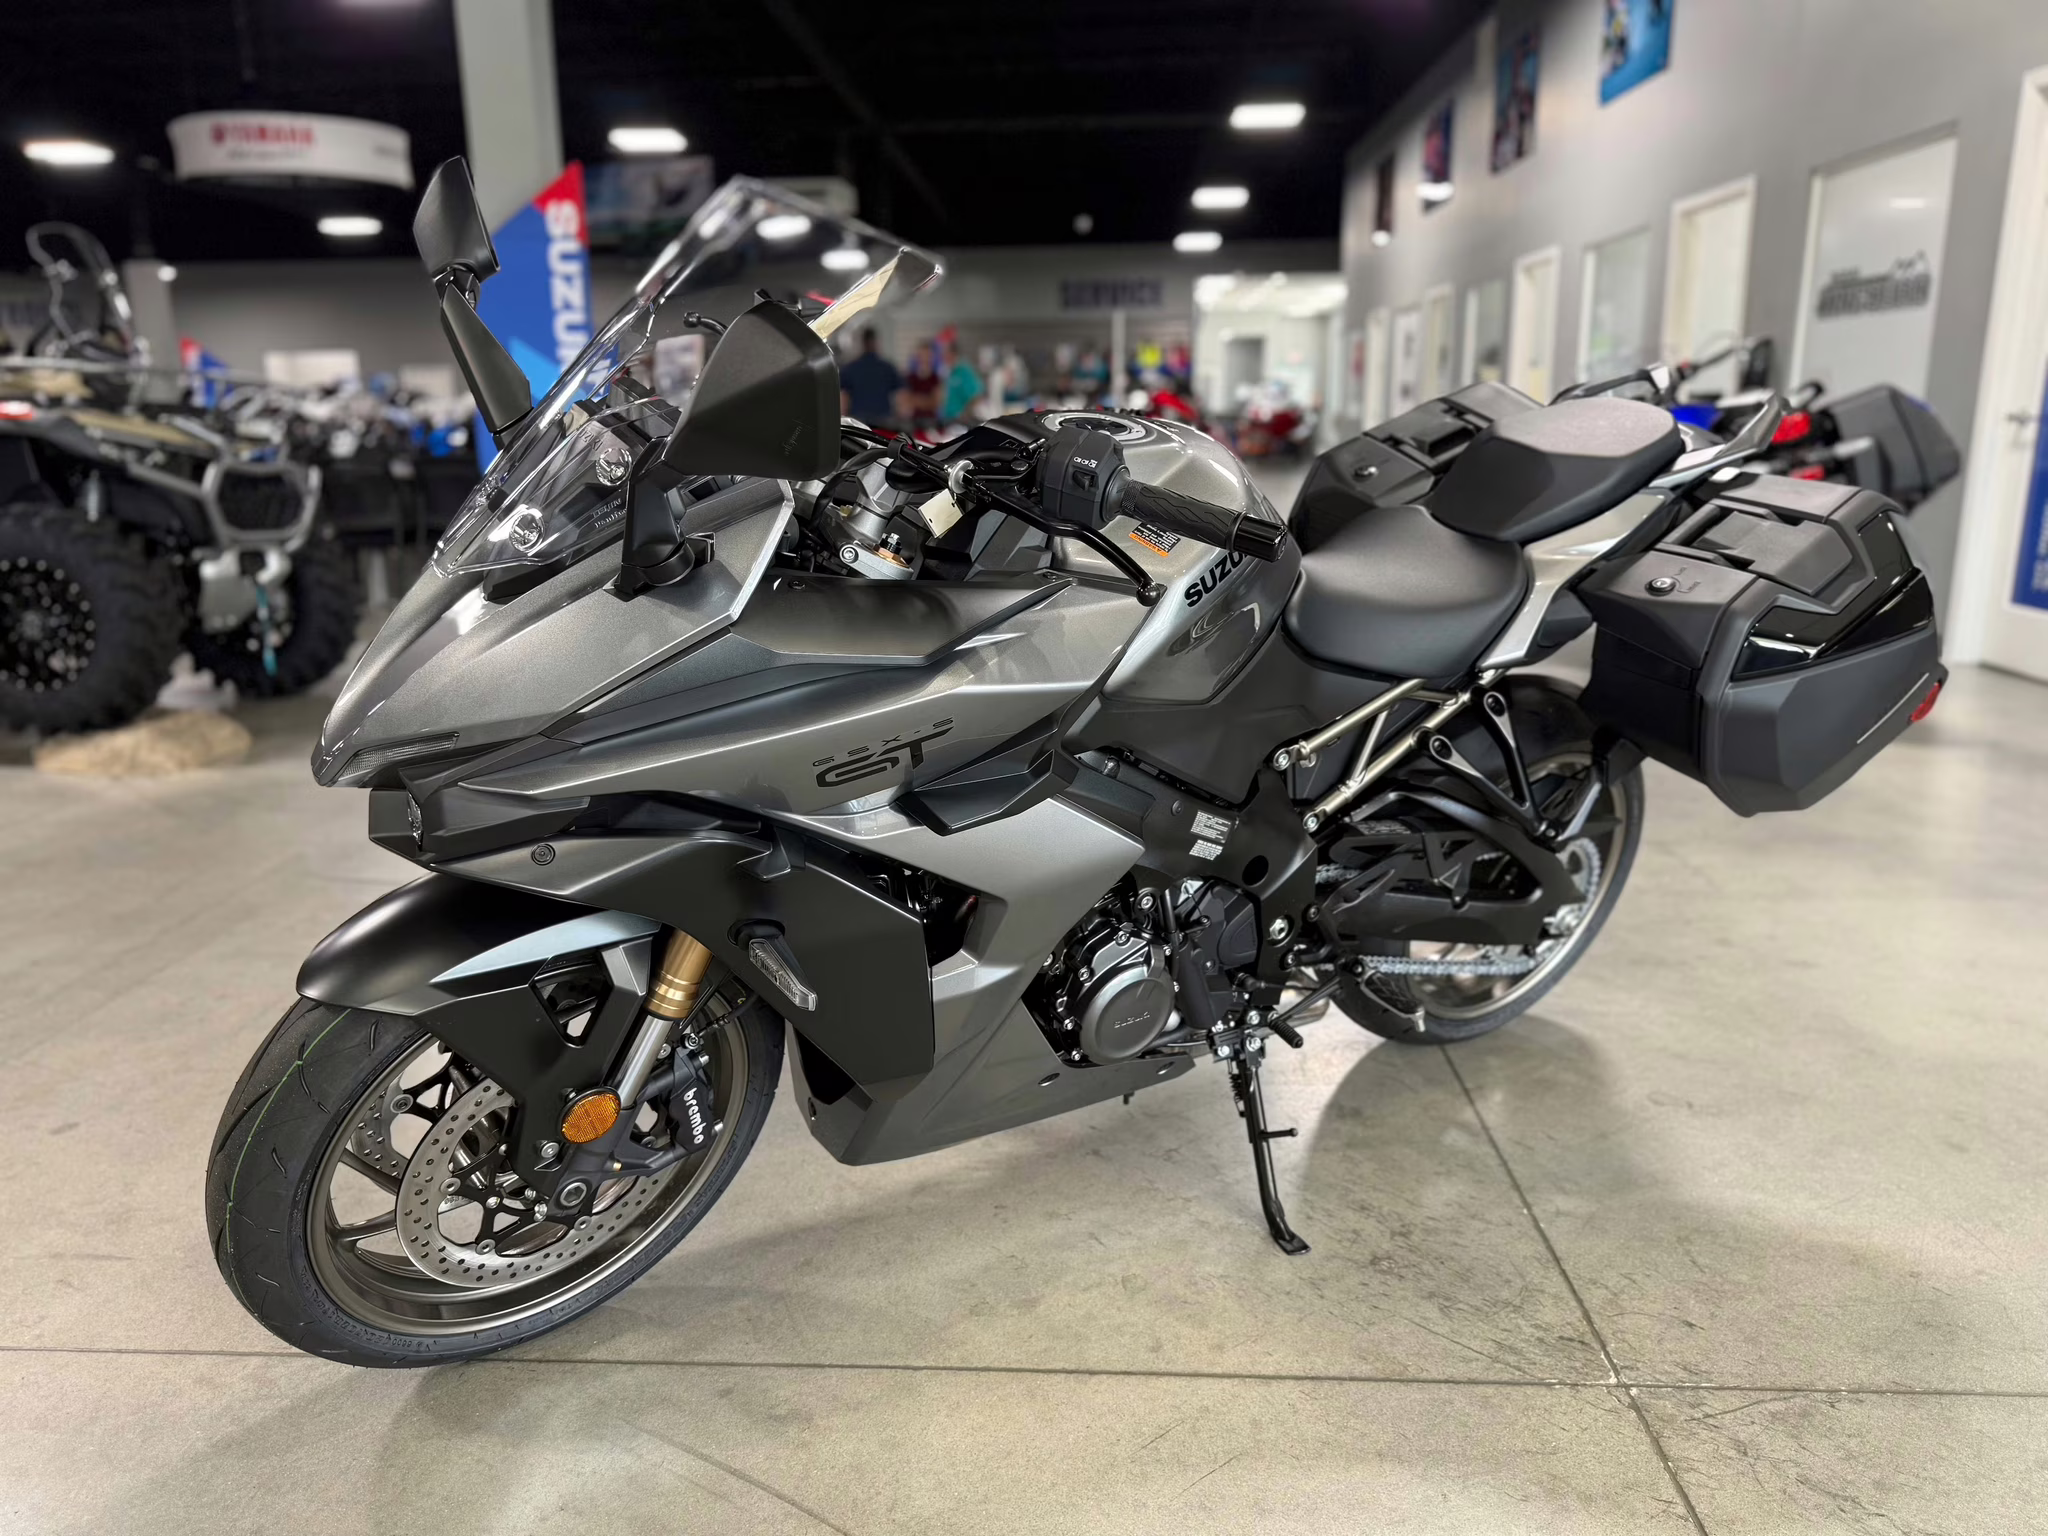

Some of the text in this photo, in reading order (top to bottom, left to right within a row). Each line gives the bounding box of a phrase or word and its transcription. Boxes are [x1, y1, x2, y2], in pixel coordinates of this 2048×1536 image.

[1184, 551, 1250, 608] SUZU
[812, 716, 955, 768] GSX-S
[815, 725, 955, 788] GT
[683, 1086, 708, 1145] brembo
